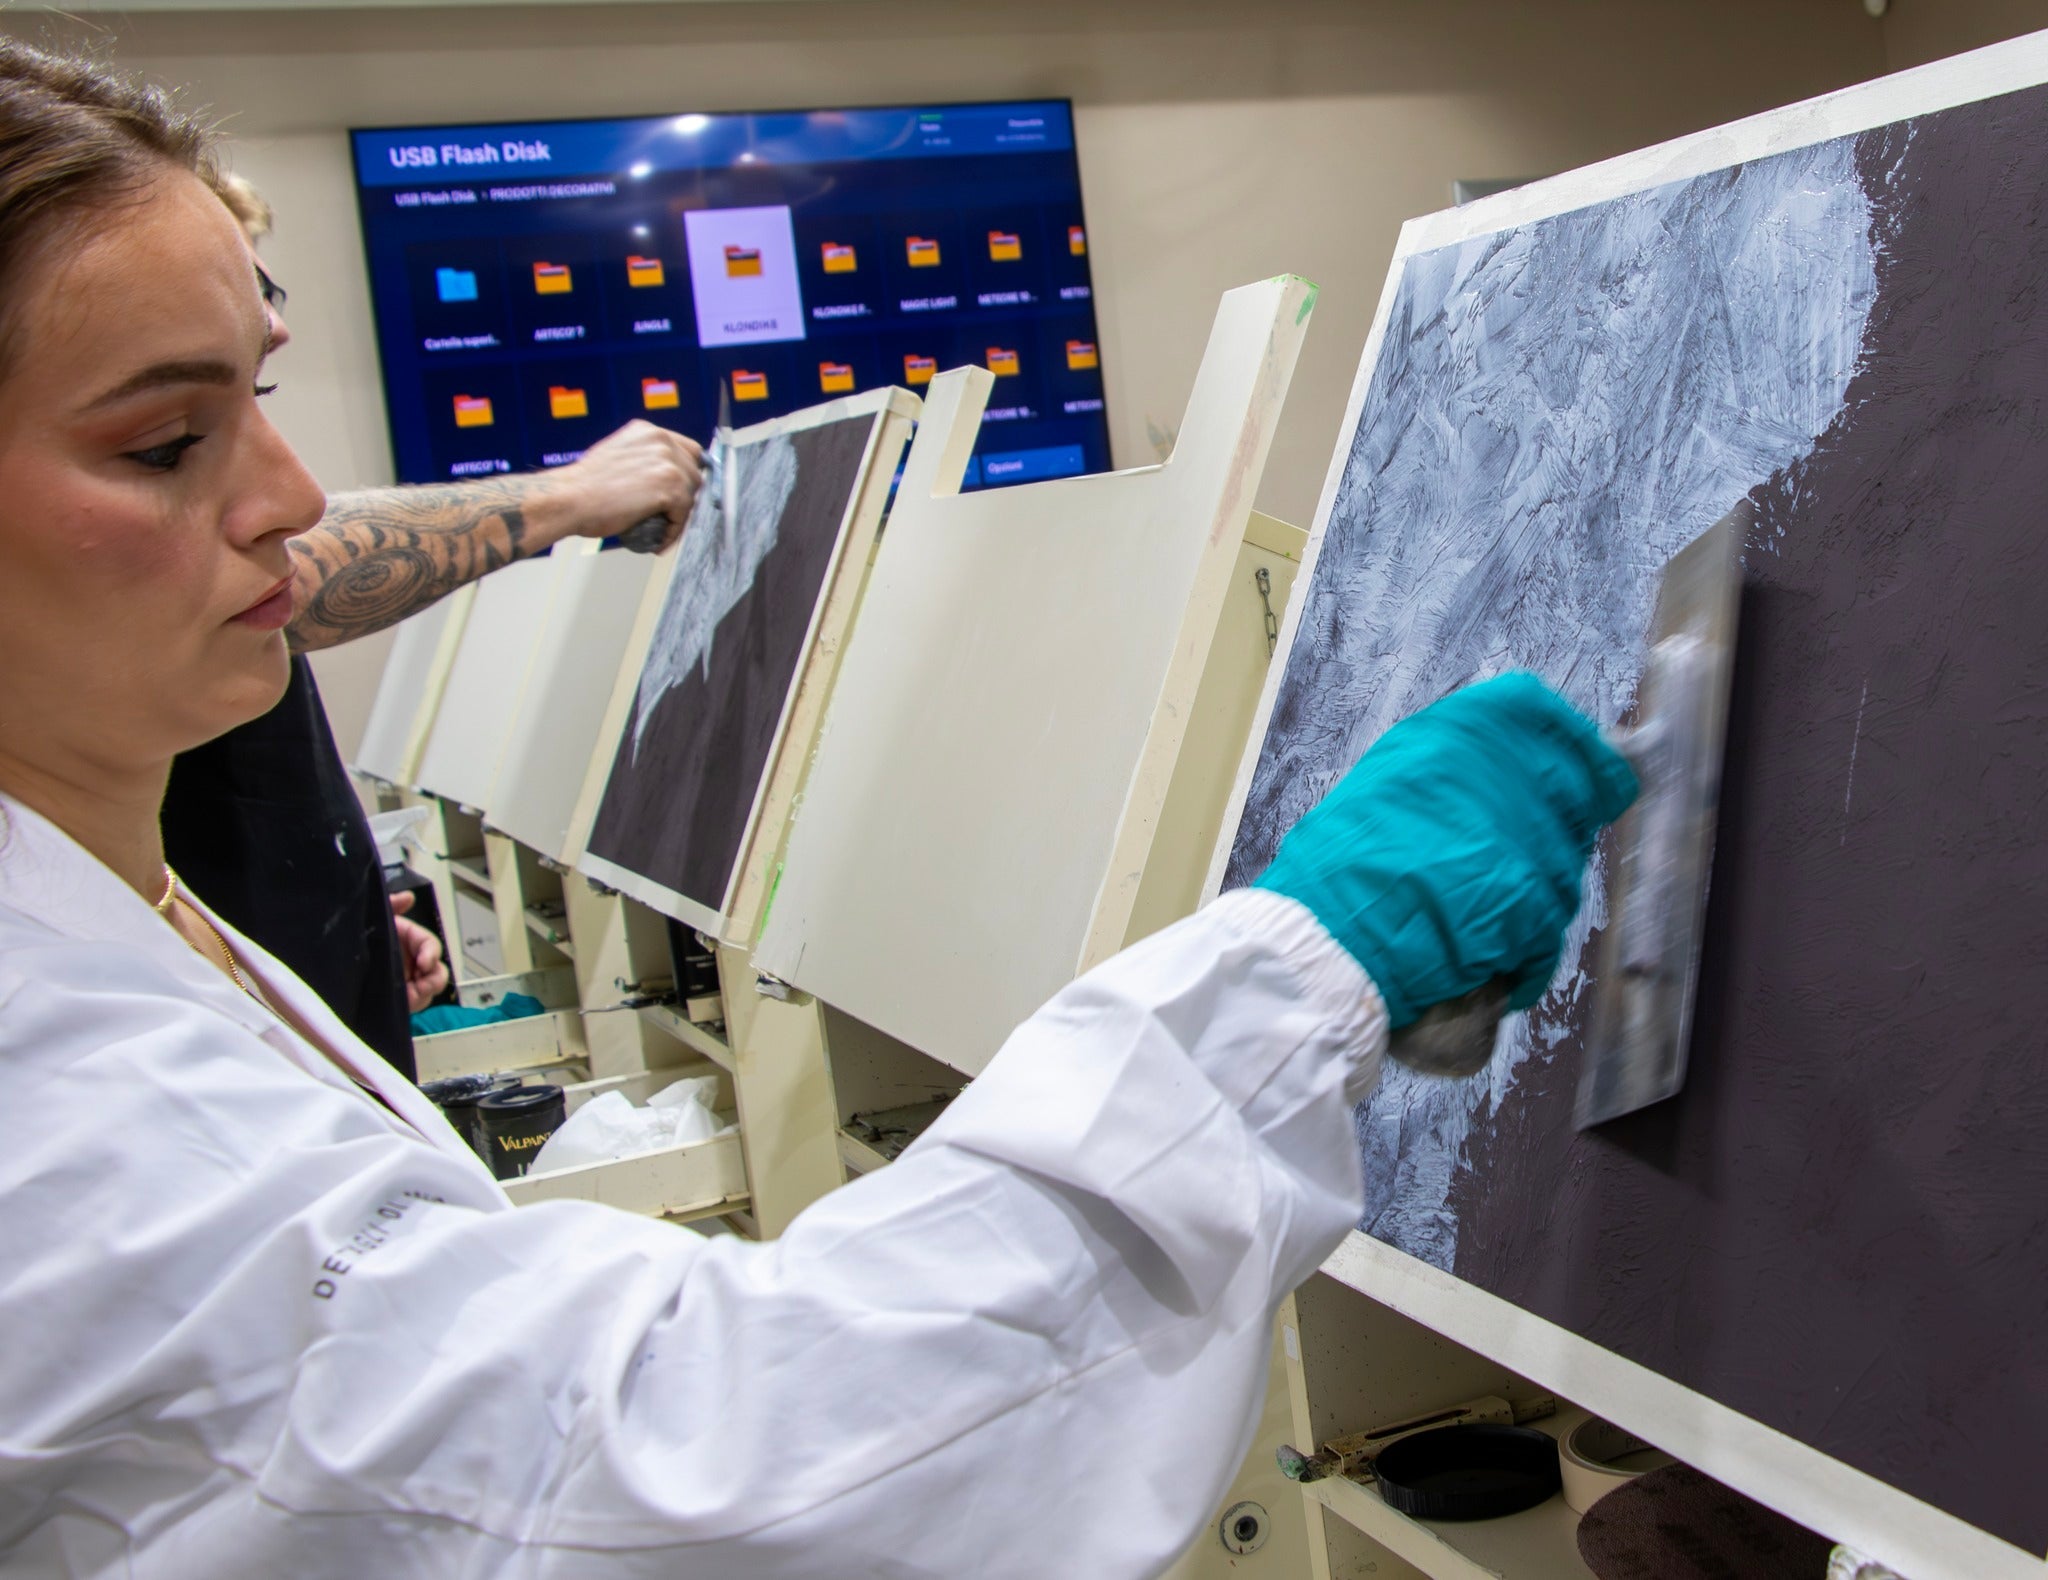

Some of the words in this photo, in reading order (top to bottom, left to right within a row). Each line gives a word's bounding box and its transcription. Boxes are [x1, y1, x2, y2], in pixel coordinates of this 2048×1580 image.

[389, 146, 438, 168] USB
[440, 143, 500, 166] Flash
[502, 140, 552, 163] Disk
[395, 193, 419, 207] USB
[421, 191, 450, 205] Flash
[451, 189, 478, 204] Disk
[723, 319, 778, 334] KLONDIKE
